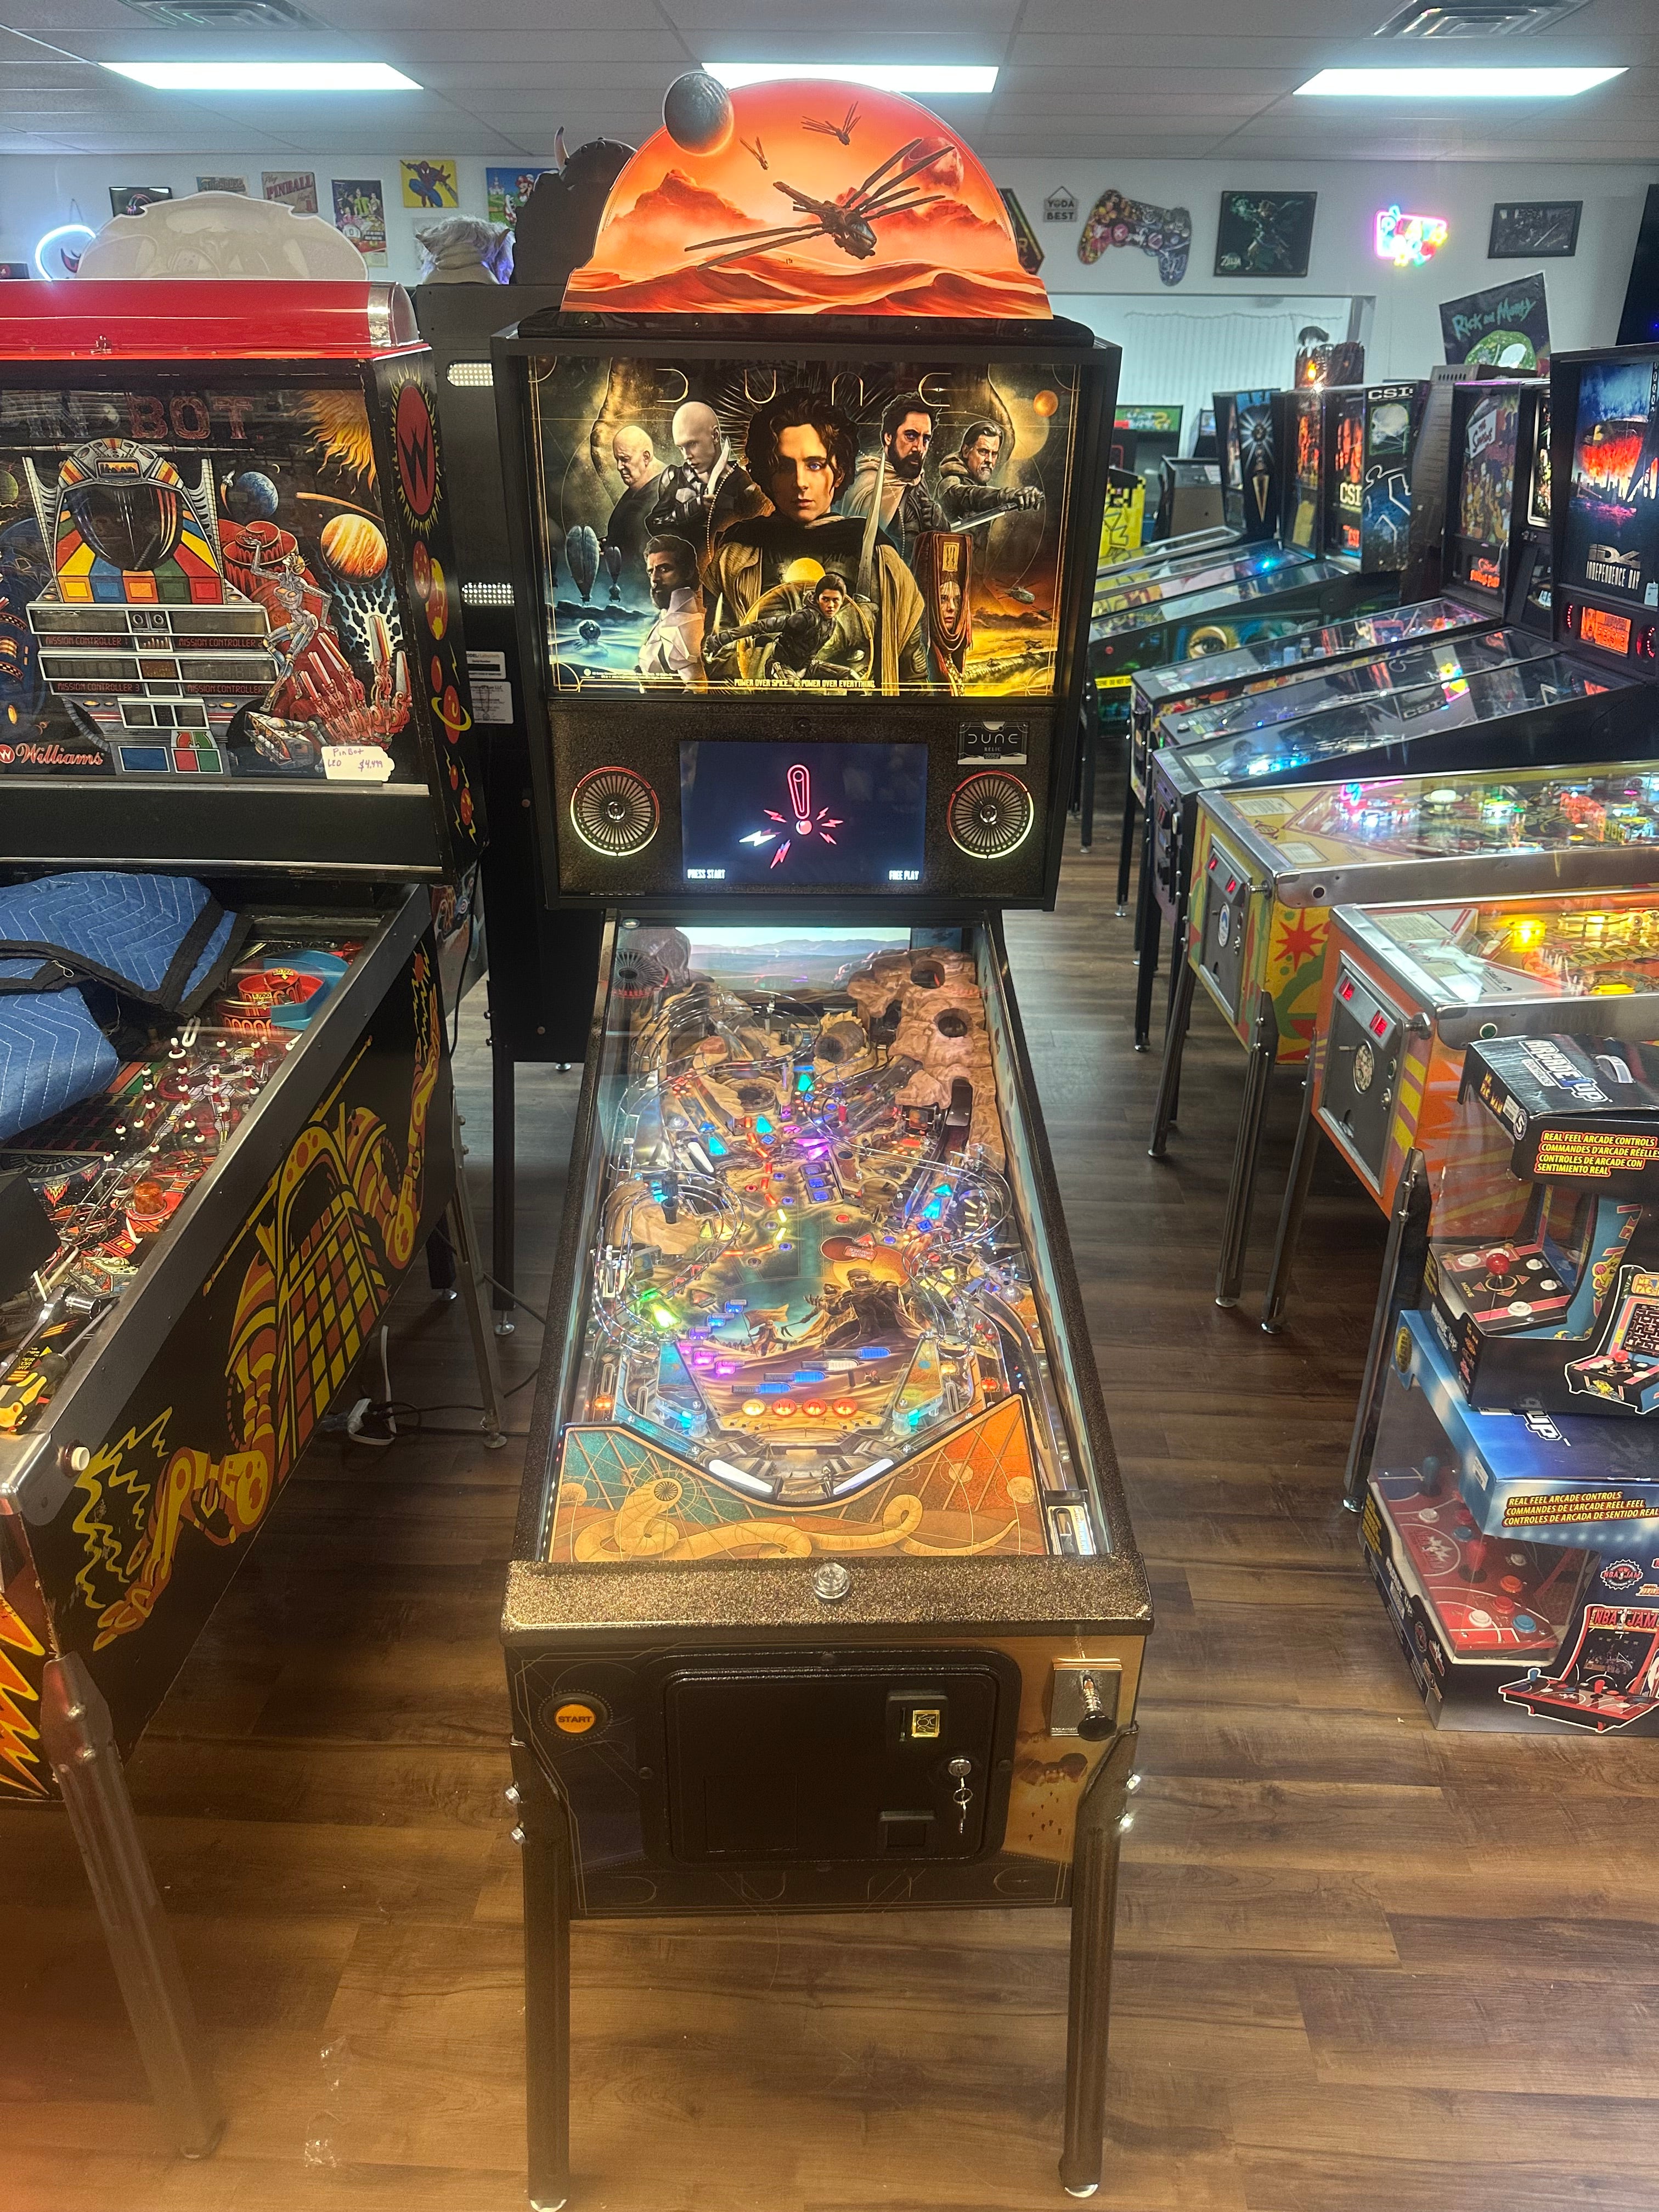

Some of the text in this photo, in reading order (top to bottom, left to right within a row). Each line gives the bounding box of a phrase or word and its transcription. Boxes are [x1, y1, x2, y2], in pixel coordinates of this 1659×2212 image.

[266, 174, 314, 199] PINBALL
[656, 368, 951, 407] DUNE
[124, 392, 253, 439] BOT
[1340, 482, 1362, 506] CSI
[46, 636, 74, 645] MISSION
[75, 636, 122, 646] CONTROLLER
[178, 638, 207, 647] MISSION
[208, 639, 256, 648] CONTROLLER
[58, 682, 140, 692] MISSION CONTROLLER 3
[187, 684, 215, 693] MISSION
[216, 685, 263, 694] CONTROLLER
[967, 733, 1021, 744] DUNE
[15, 743, 103, 765] Williams
[687, 869, 920, 881] PRESS START FREE PLAY
[1543, 1132, 1655, 1147] REAL FEEL ARCADE CONTROLS
[1541, 1143, 1590, 1154] COMMANDES
[1591, 1146, 1629, 1156] D'ARCADE
[1539, 1154, 1643, 1168] CONTROLES DE ARCADE CON
[1537, 1163, 1609, 1175] SENTIMIENTO REAL
[1460, 1282, 1475, 1297] MOVE
[1509, 1491, 1622, 1506] REAL FEEL ARCADE CONTROLS
[1506, 1499, 1645, 1516] COMMANDES DE L'ARCADE REEL FEEL
[1504, 1508, 1658, 1526] CONTROLES DE ARCADA DE SENTIDO REAL
[1594, 1609, 1658, 1628] NBA JAM
